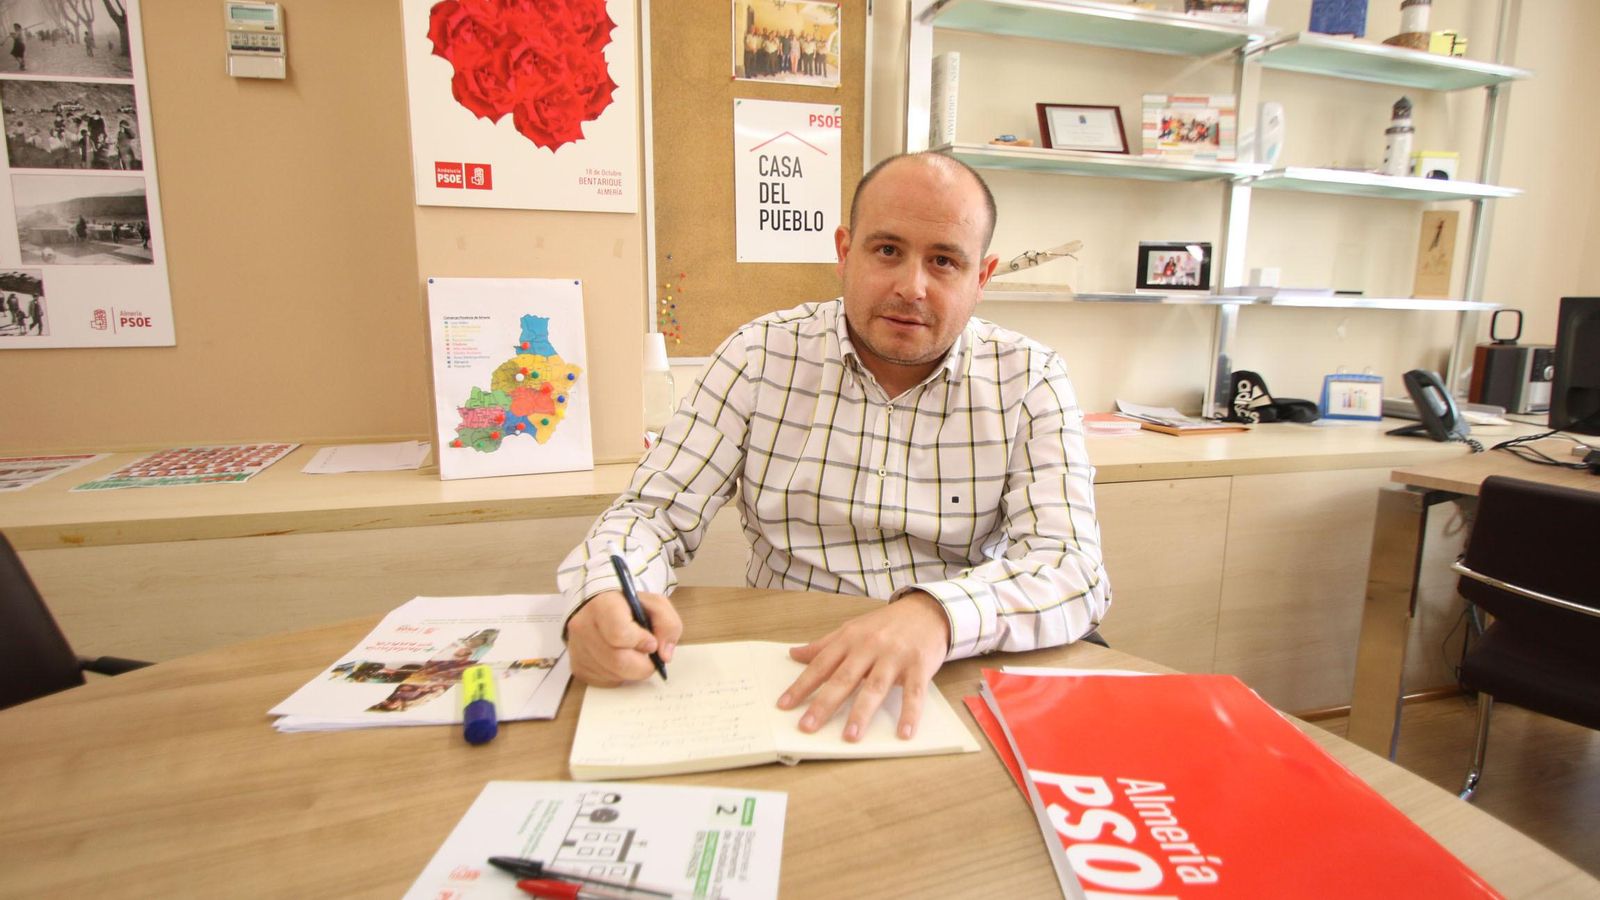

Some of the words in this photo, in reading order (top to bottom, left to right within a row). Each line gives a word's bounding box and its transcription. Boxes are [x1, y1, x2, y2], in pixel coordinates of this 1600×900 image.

[809, 114, 842, 128] PSOE
[759, 154, 803, 178] CASA
[437, 173, 462, 184] PSOE
[578, 176, 622, 187] BENTARIQUE
[759, 182, 790, 204] DEL
[760, 209, 824, 231] PUEBLO
[120, 317, 152, 328] PSOE
[716, 804, 738, 816] 2
[1027, 769, 1180, 900] PSO
[1116, 776, 1223, 885] Almería
